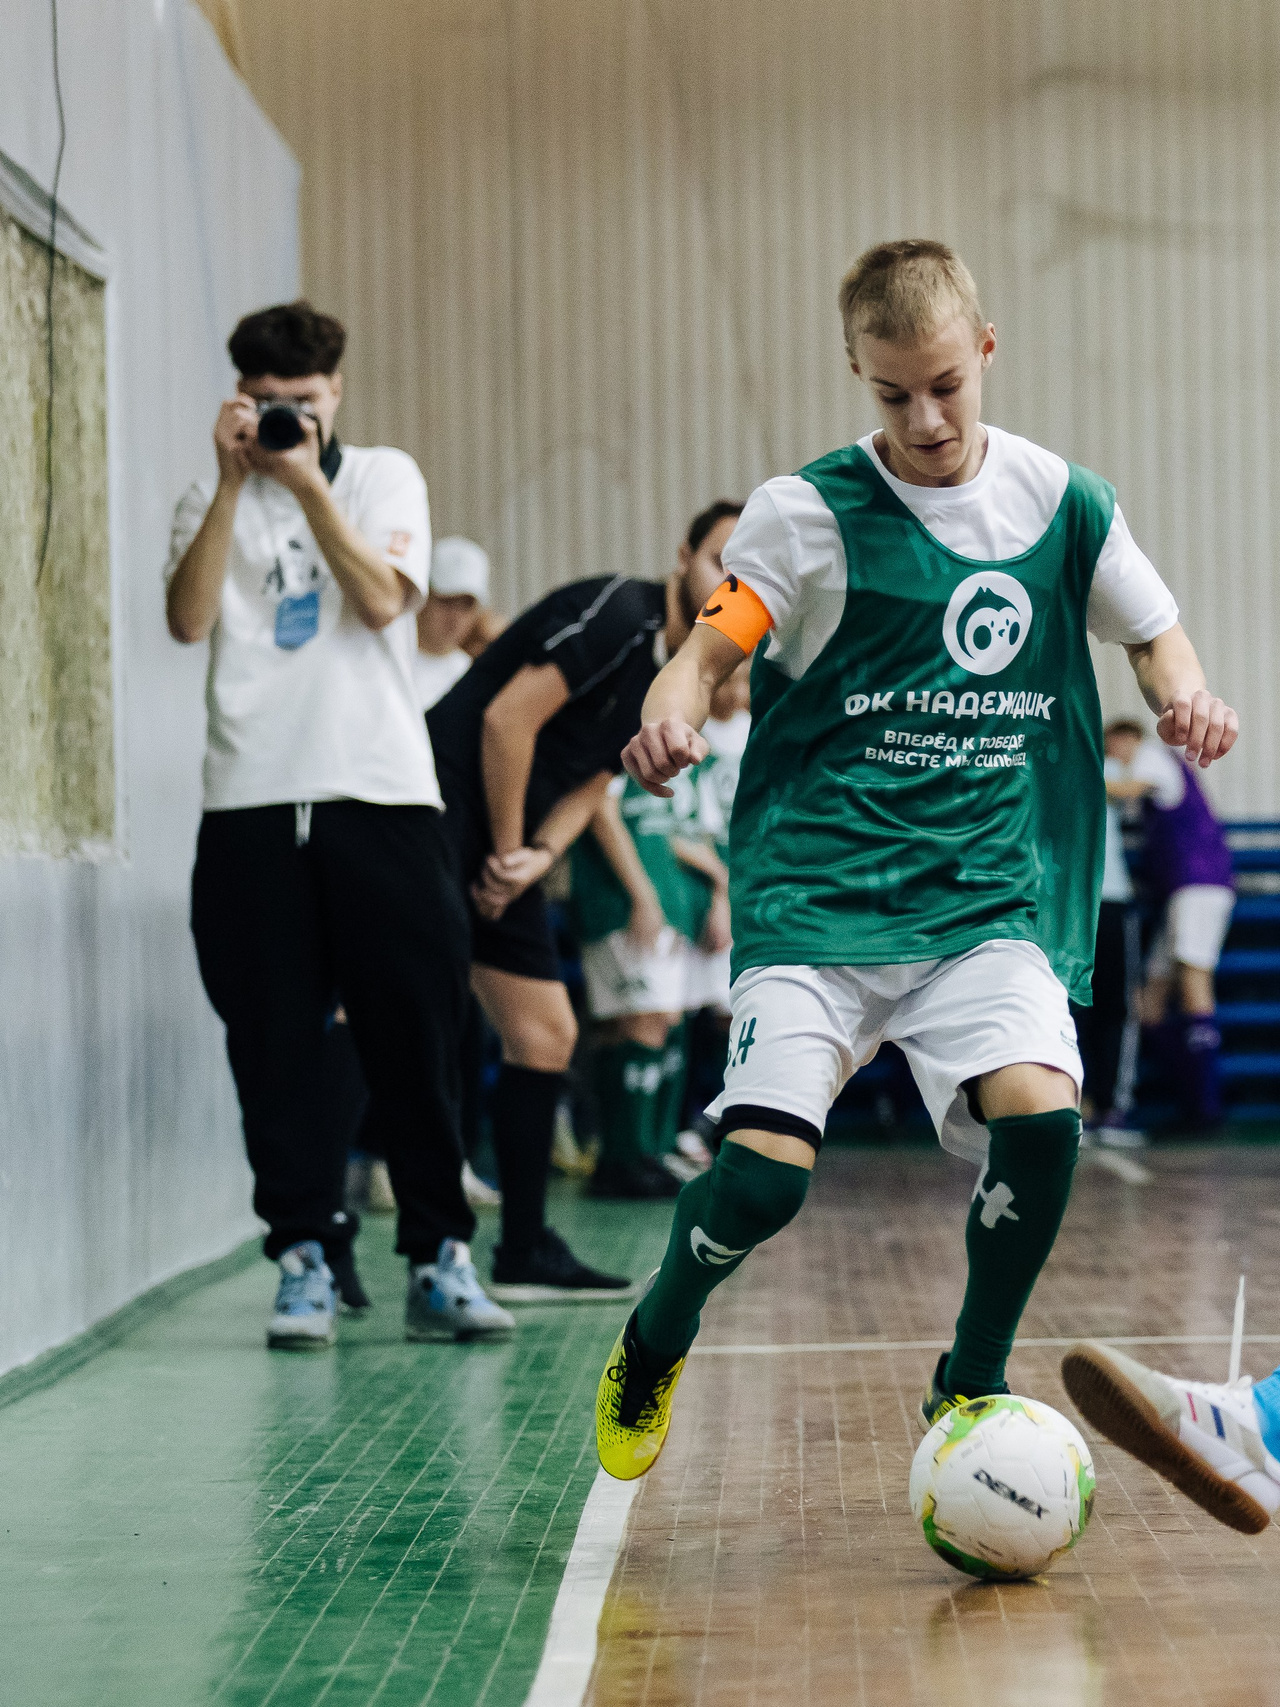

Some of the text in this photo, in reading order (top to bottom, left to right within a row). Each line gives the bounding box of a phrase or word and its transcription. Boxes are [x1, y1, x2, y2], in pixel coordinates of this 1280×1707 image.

[844, 691, 1056, 721] ФК НАДЕЖДИК
[883, 730, 958, 752] ВПЕРЁД
[962, 736, 975, 751] К
[865, 747, 940, 768] ВМЕСТЕ
